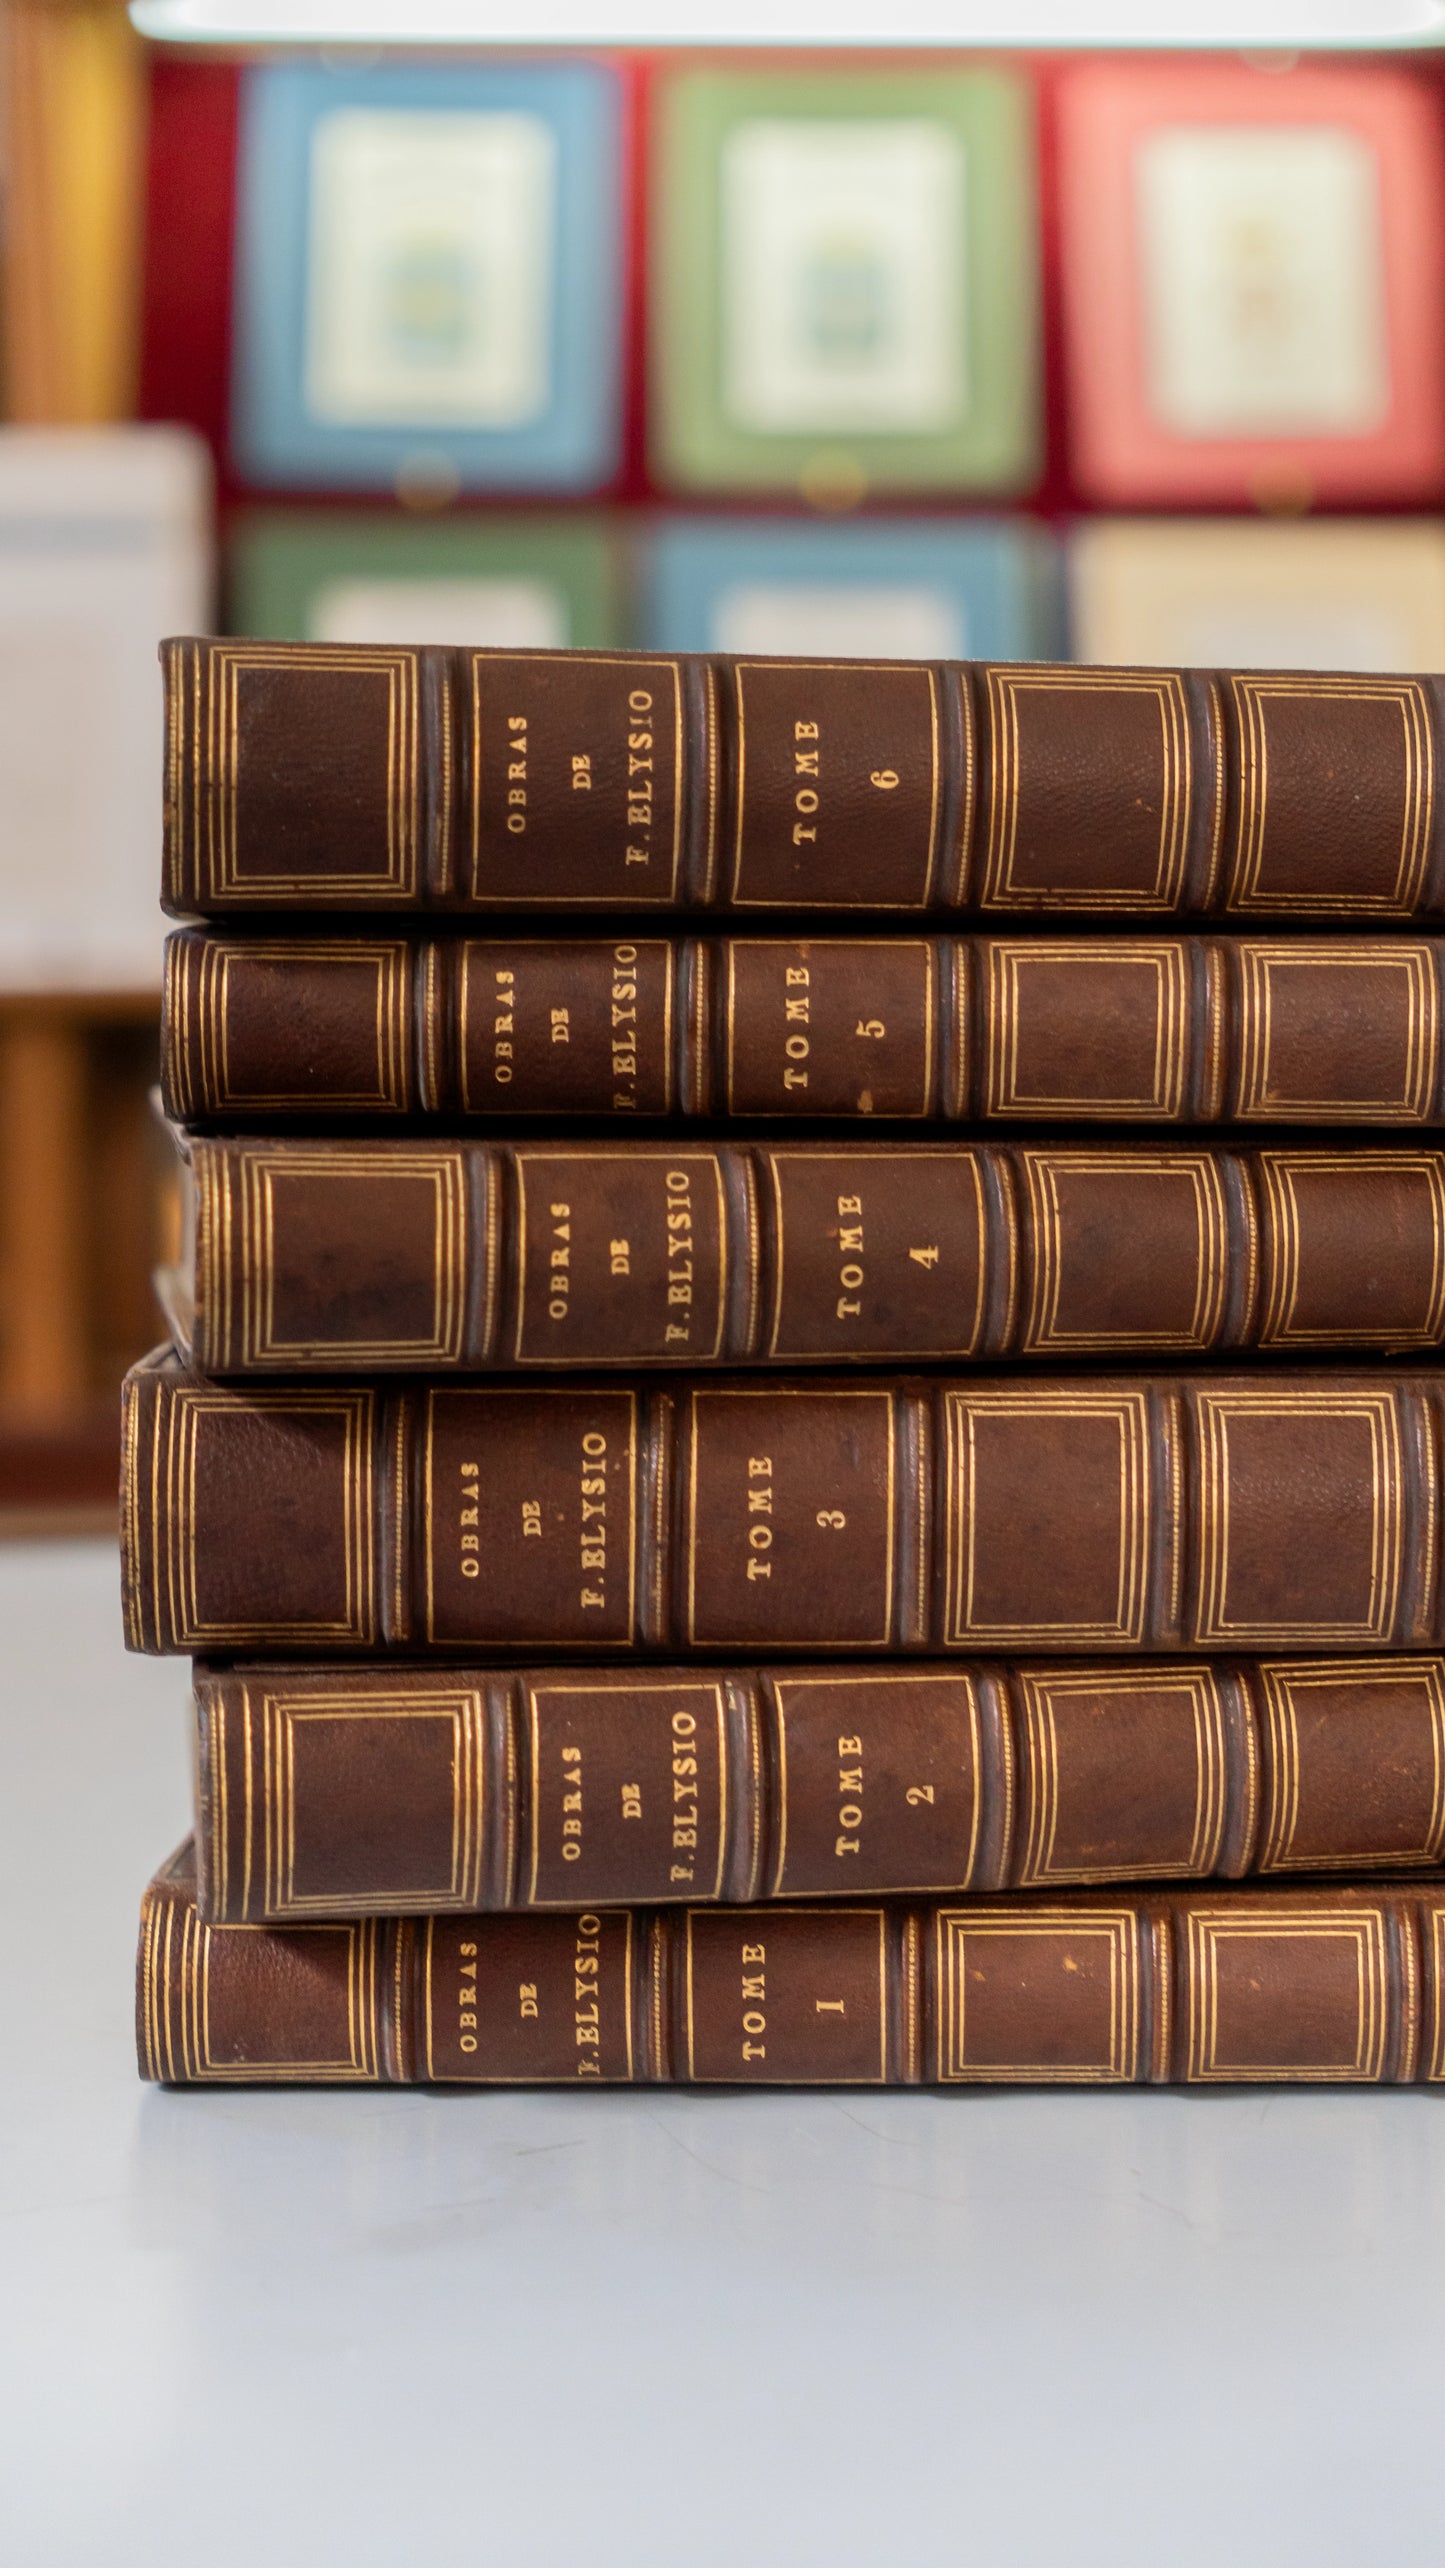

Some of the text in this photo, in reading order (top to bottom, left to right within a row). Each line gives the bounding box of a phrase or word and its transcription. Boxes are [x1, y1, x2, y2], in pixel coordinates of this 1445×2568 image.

[507, 716, 529, 833] OBRAS
[571, 754, 592, 790] DE
[792, 720, 820, 846] TOME
[870, 769, 900, 790] 6
[494, 970, 517, 1083] OBRAS
[550, 1007, 570, 1043] DE
[784, 966, 811, 1090] TOME
[855, 1019, 886, 1039] 5
[549, 1202, 572, 1319] OBRAS
[609, 1238, 630, 1275] DE
[836, 1194, 864, 1320] TOME
[909, 1245, 940, 1270] 4
[459, 1462, 480, 1578] OBRAS
[521, 1500, 542, 1537] DE
[746, 1456, 773, 1581] TOME
[816, 1510, 847, 1530] 3
[561, 1746, 583, 1861] OBRAS
[621, 1783, 642, 1819] DE
[835, 1735, 864, 1857] TOME
[905, 1784, 935, 1806] 2
[458, 1942, 478, 2053] OBRAS
[519, 1983, 539, 2019] DE
[741, 1944, 767, 2062] TOME
[815, 1999, 845, 2014] 1
